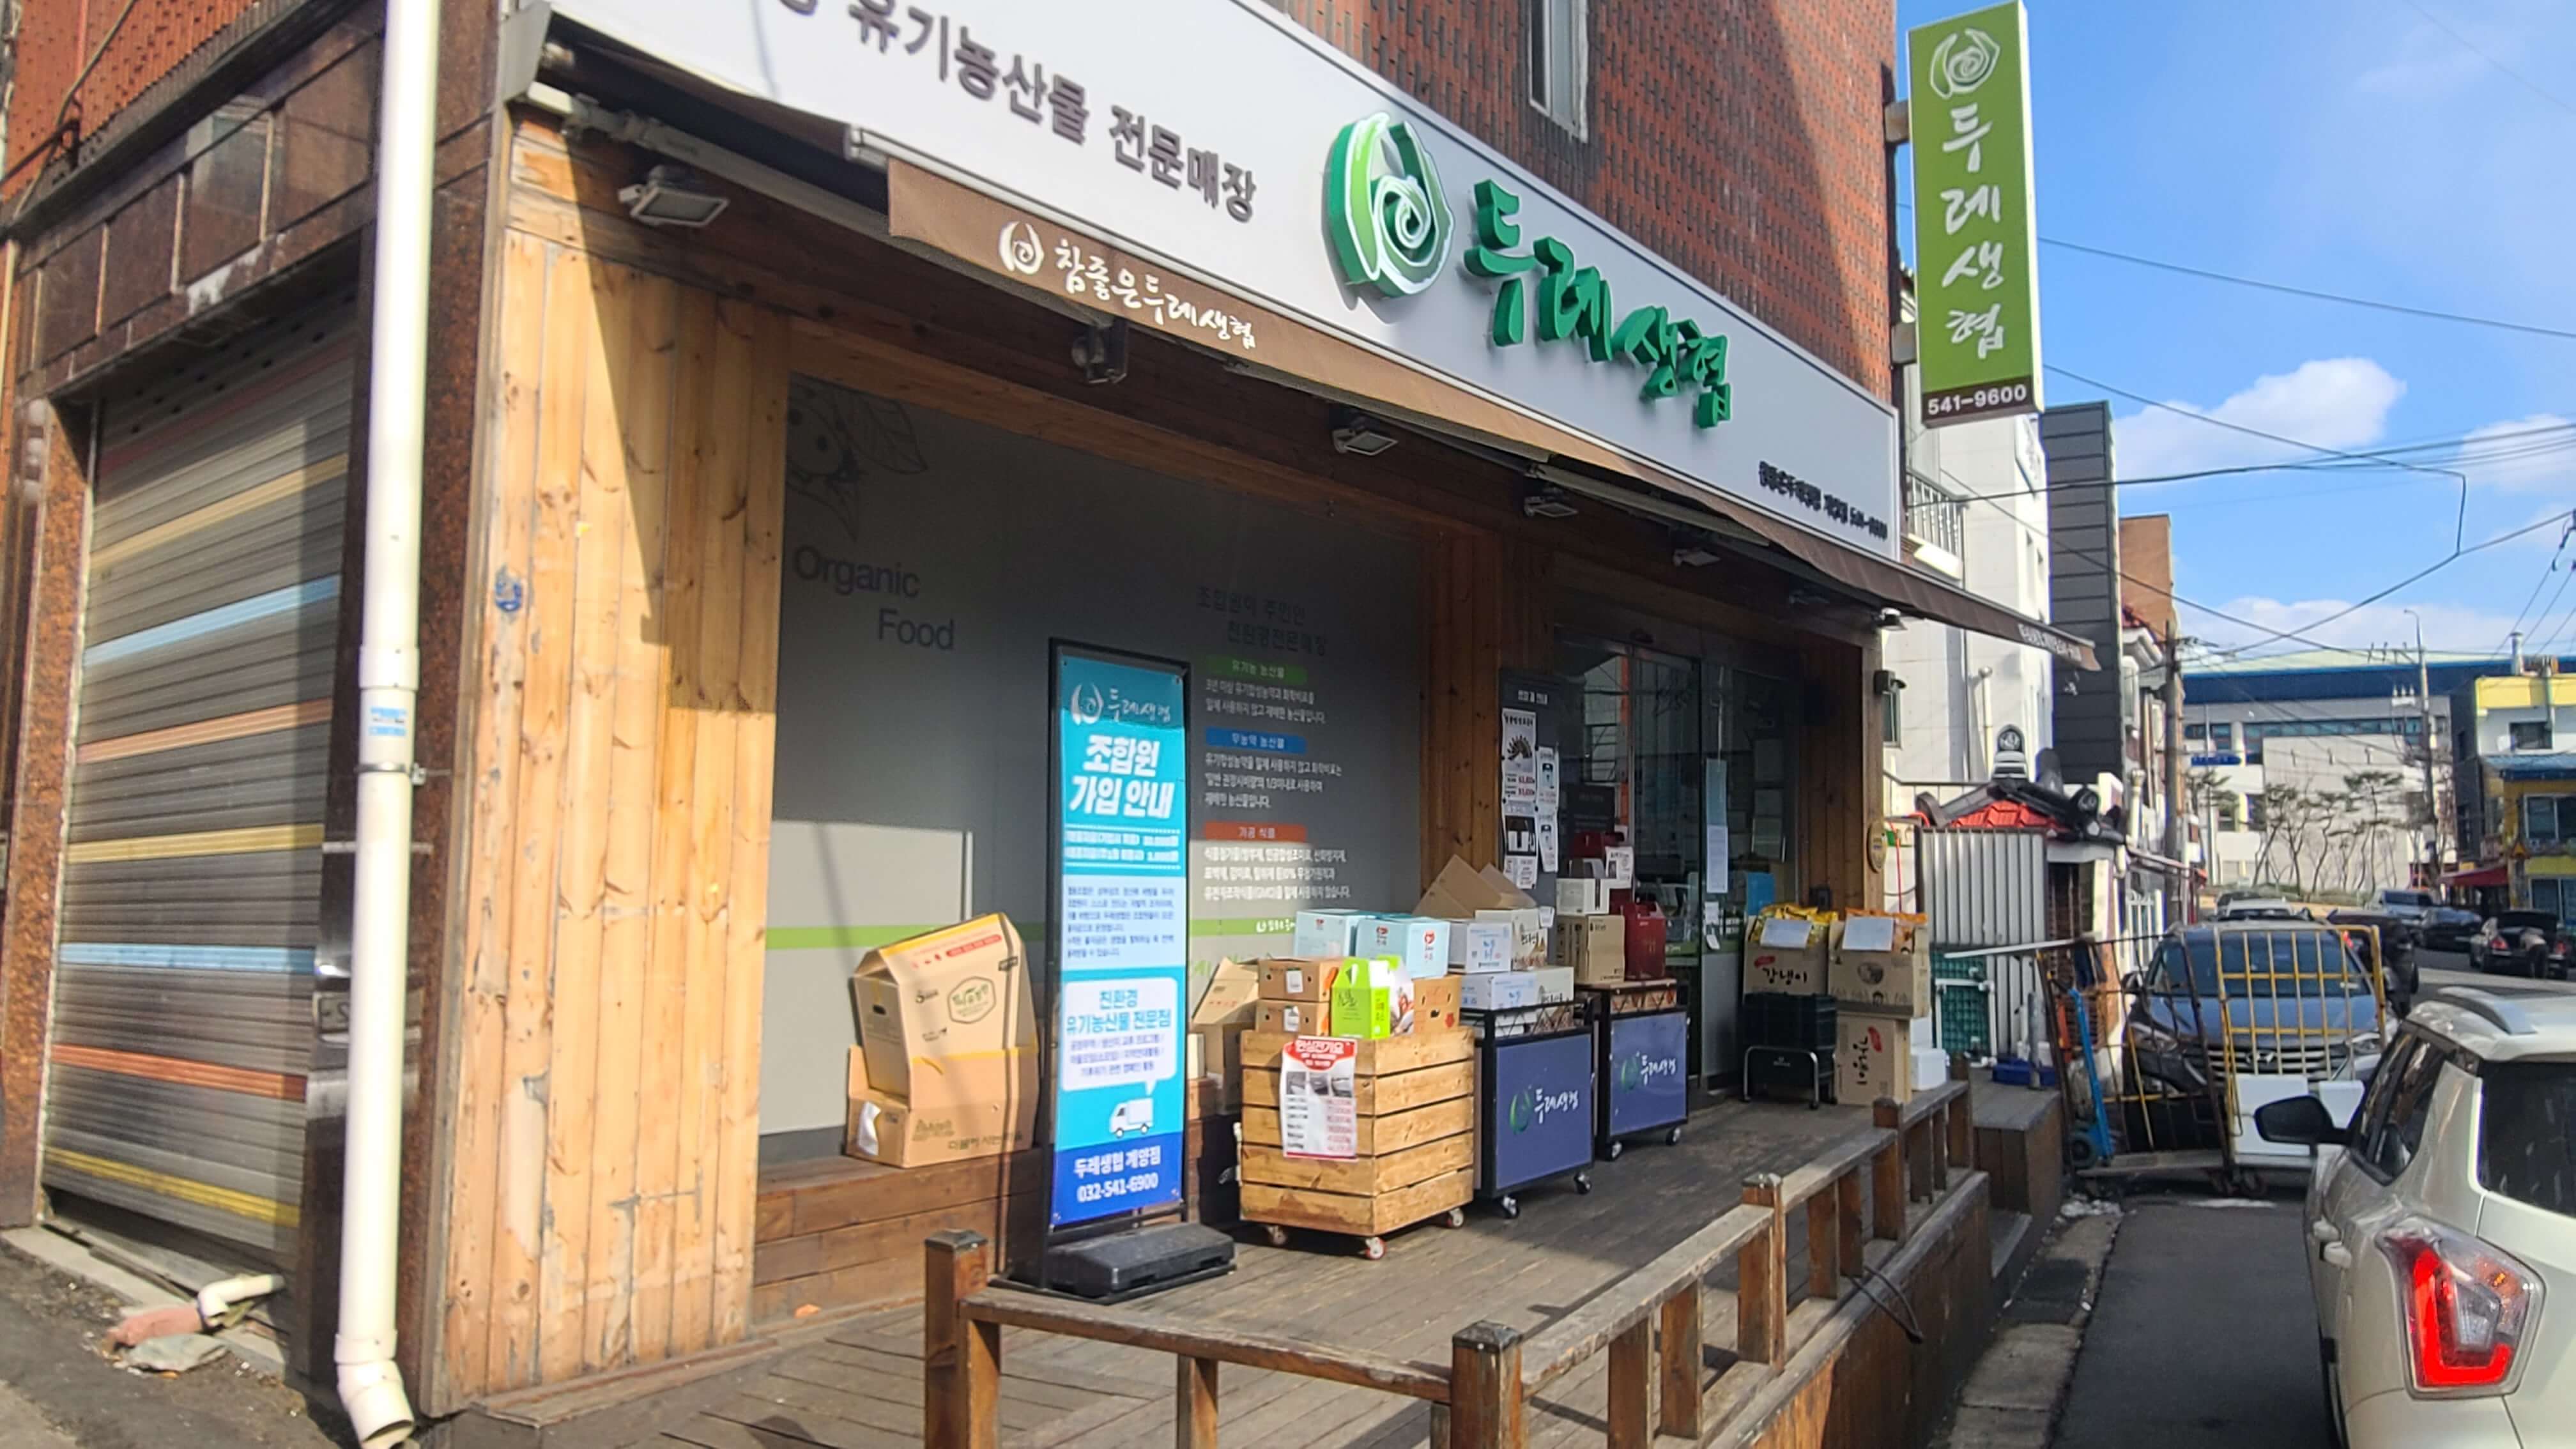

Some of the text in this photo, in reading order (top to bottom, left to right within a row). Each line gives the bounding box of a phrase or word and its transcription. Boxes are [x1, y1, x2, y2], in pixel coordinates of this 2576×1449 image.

[1108, 104, 1257, 224] 전문매장
[1942, 102, 2005, 360] 두레생협
[1463, 178, 1732, 430] 두레생협
[1928, 383, 2027, 417] 541-9600
[795, 545, 921, 599] Organic
[878, 607, 955, 650] Food
[1108, 687, 1171, 723] 두레생협
[1082, 733, 1161, 778] 조합원
[1069, 775, 1176, 819] 가입 안내
[1762, 967, 1809, 986] 강냉이
[1100, 988, 1138, 1010] 친환경
[1066, 1008, 1172, 1036] 유기농산물 전문점
[1073, 1144, 1162, 1179] 두레생협 계양점
